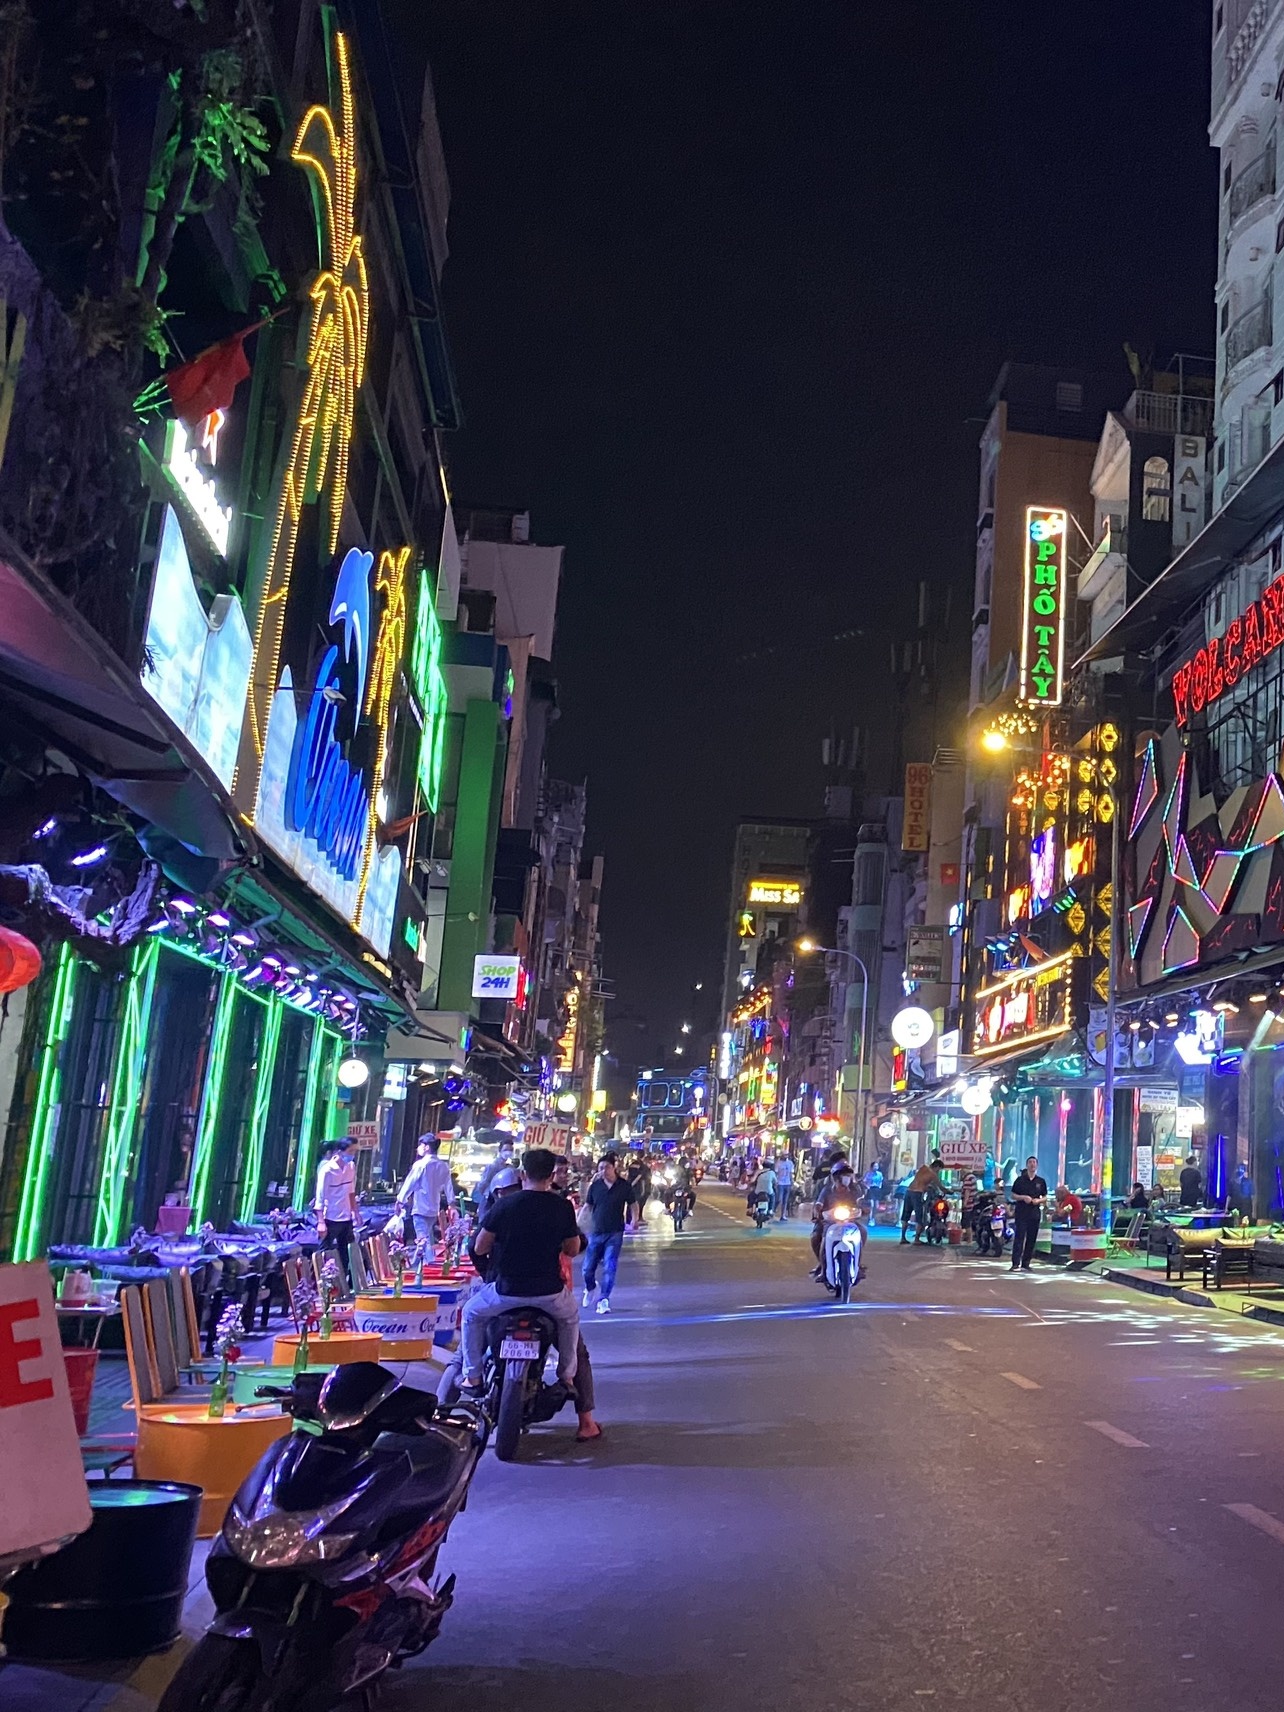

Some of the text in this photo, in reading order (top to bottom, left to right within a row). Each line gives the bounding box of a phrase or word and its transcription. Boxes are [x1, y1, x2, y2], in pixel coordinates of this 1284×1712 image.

[1179, 440, 1200, 540] BALI
[1031, 541, 1058, 697] PHỐ TÂY
[908, 786, 927, 848] HOTEL
[480, 964, 516, 976] SHOP
[480, 976, 511, 988] 24H
[364, 1125, 376, 1134] XE
[524, 1123, 567, 1147] GIỮ XE
[968, 1142, 987, 1153] XE
[362, 1317, 408, 1333] Ocean
